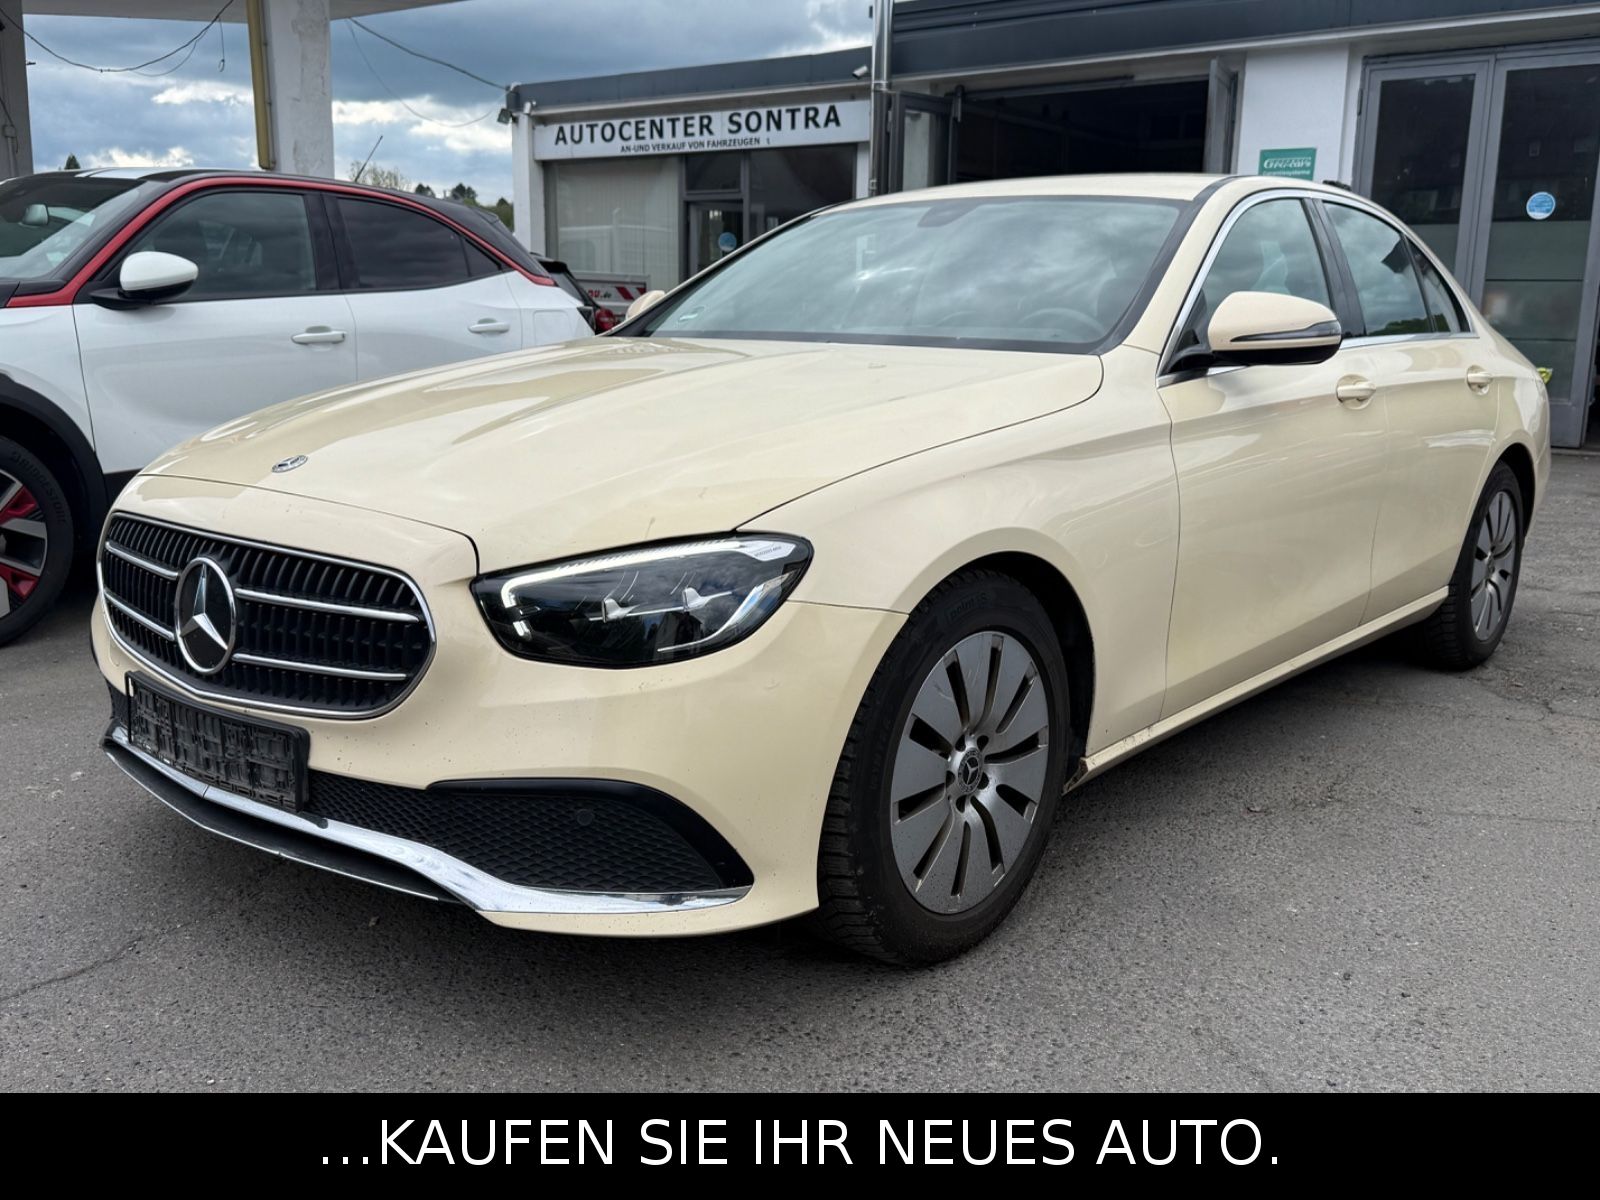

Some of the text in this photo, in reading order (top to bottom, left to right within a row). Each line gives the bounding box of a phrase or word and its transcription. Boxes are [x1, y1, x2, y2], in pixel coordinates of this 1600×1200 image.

[554, 104, 841, 146] AUTOCENTER SONTRA
[652, 142, 686, 151] VERKAUF
[688, 141, 705, 149] VON
[706, 138, 760, 148] FAHRZEUGEN
